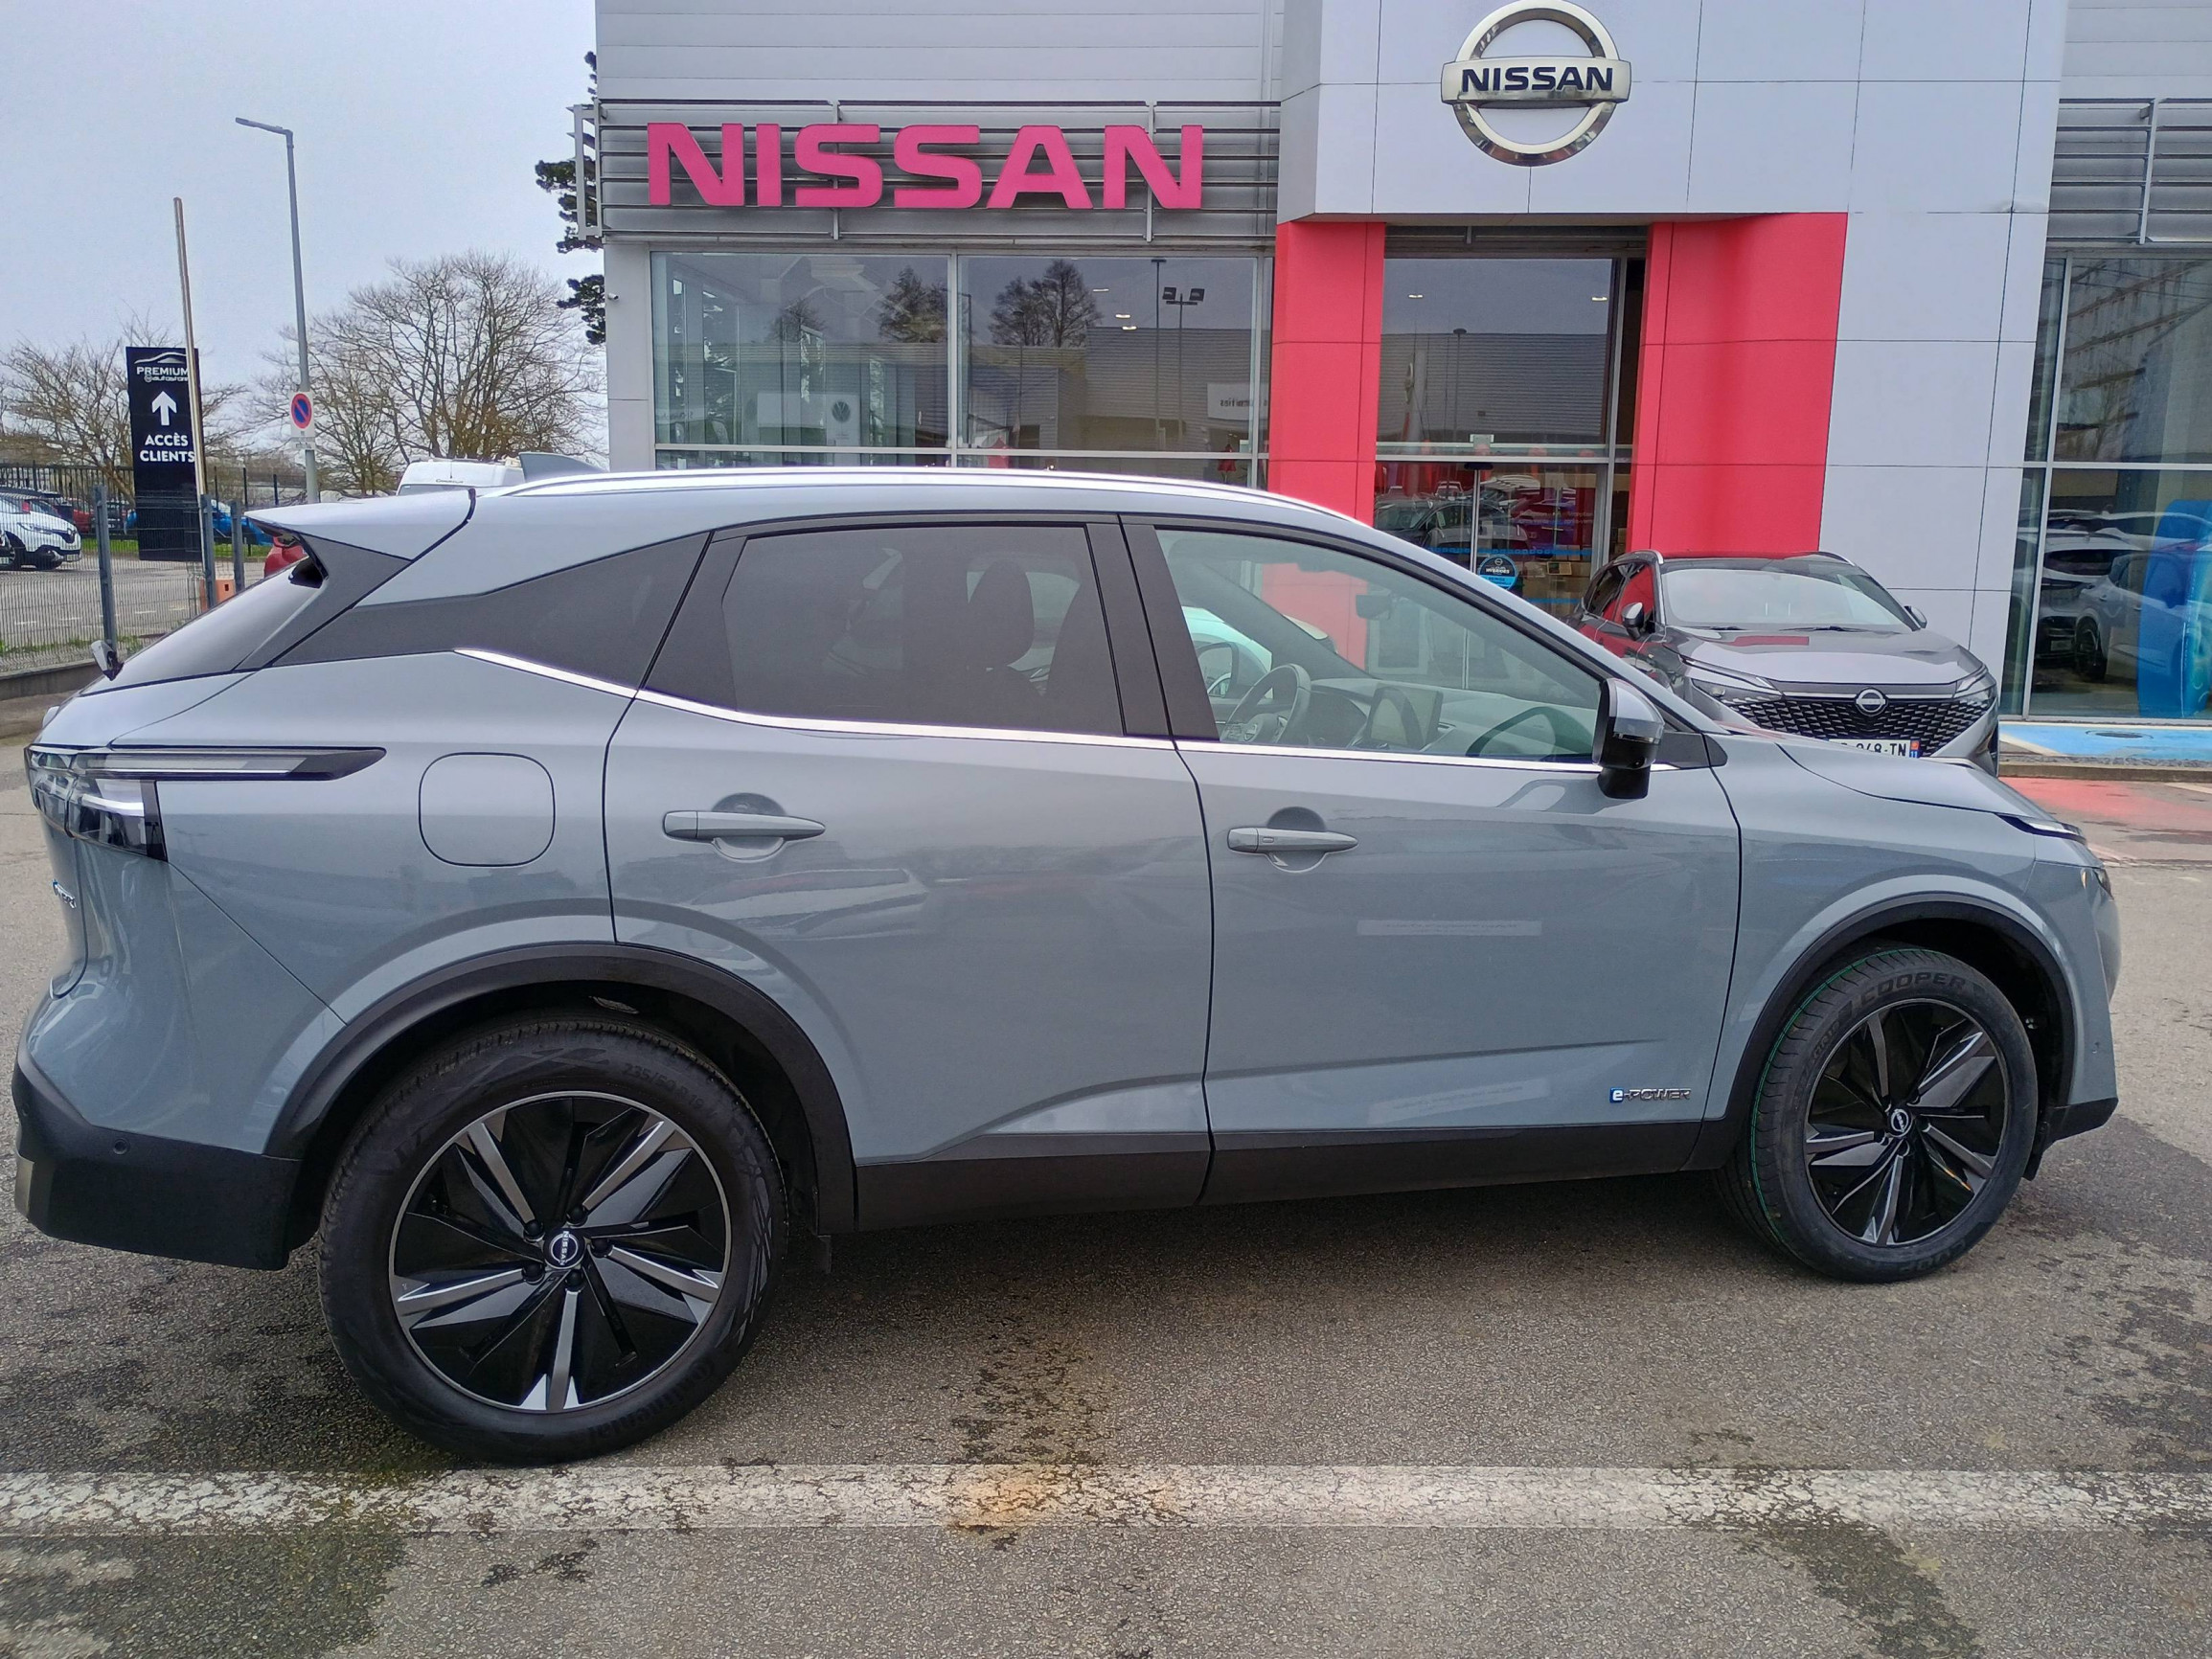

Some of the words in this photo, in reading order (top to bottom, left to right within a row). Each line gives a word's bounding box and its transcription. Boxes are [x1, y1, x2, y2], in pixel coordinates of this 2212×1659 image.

[1462, 67, 1613, 92] NISSAN
[648, 123, 1202, 209] NISSAN
[136, 367, 189, 375] PREMIUM
[145, 432, 189, 446] ACCÈS
[140, 450, 195, 463] CLIENTS
[1861, 971, 1967, 1005] COOPER
[1610, 1088, 1692, 1102] e-POWER
